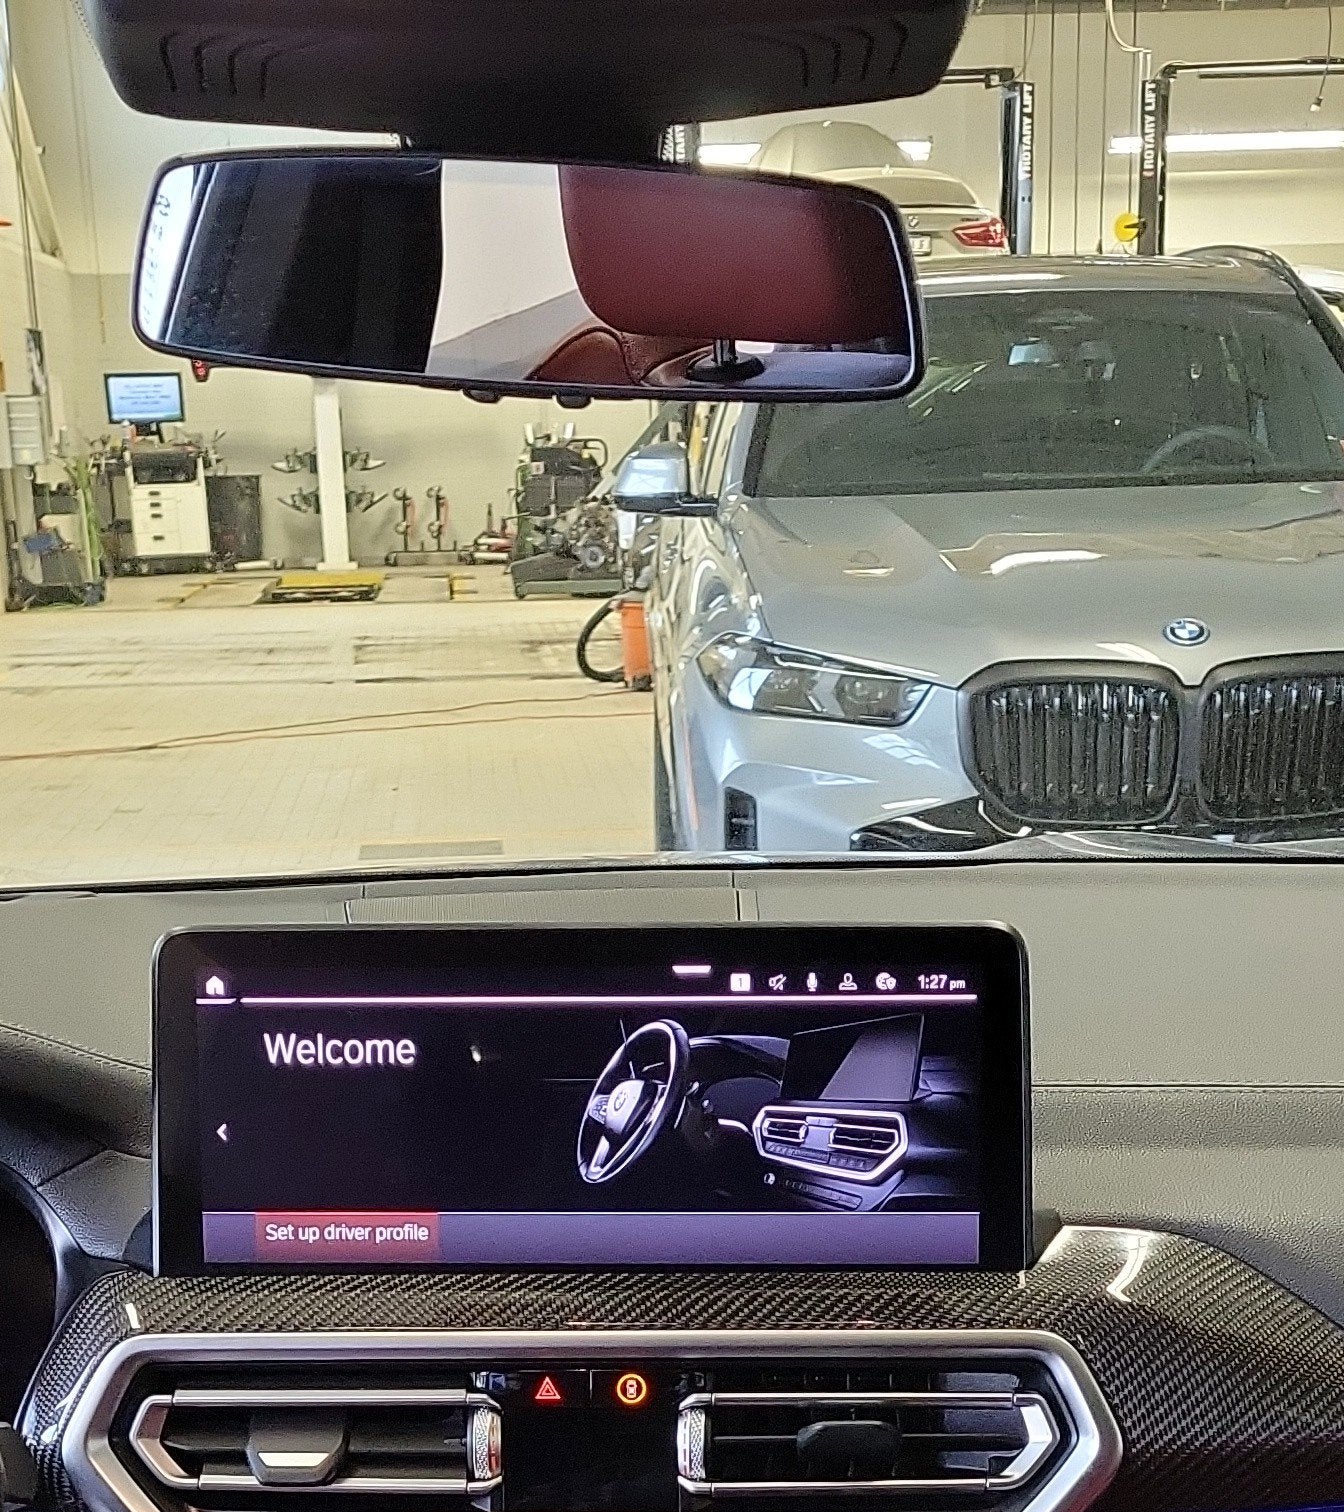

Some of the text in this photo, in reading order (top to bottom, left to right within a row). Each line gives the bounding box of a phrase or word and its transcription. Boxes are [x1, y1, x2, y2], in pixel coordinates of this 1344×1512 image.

[1022, 83, 1033, 113] LIFT
[1144, 81, 1156, 169] ROTARY LIFT
[917, 974, 966, 991] 1:27 pm
[263, 1032, 416, 1065] Welcome
[265, 1222, 430, 1244] Set up driver profile
